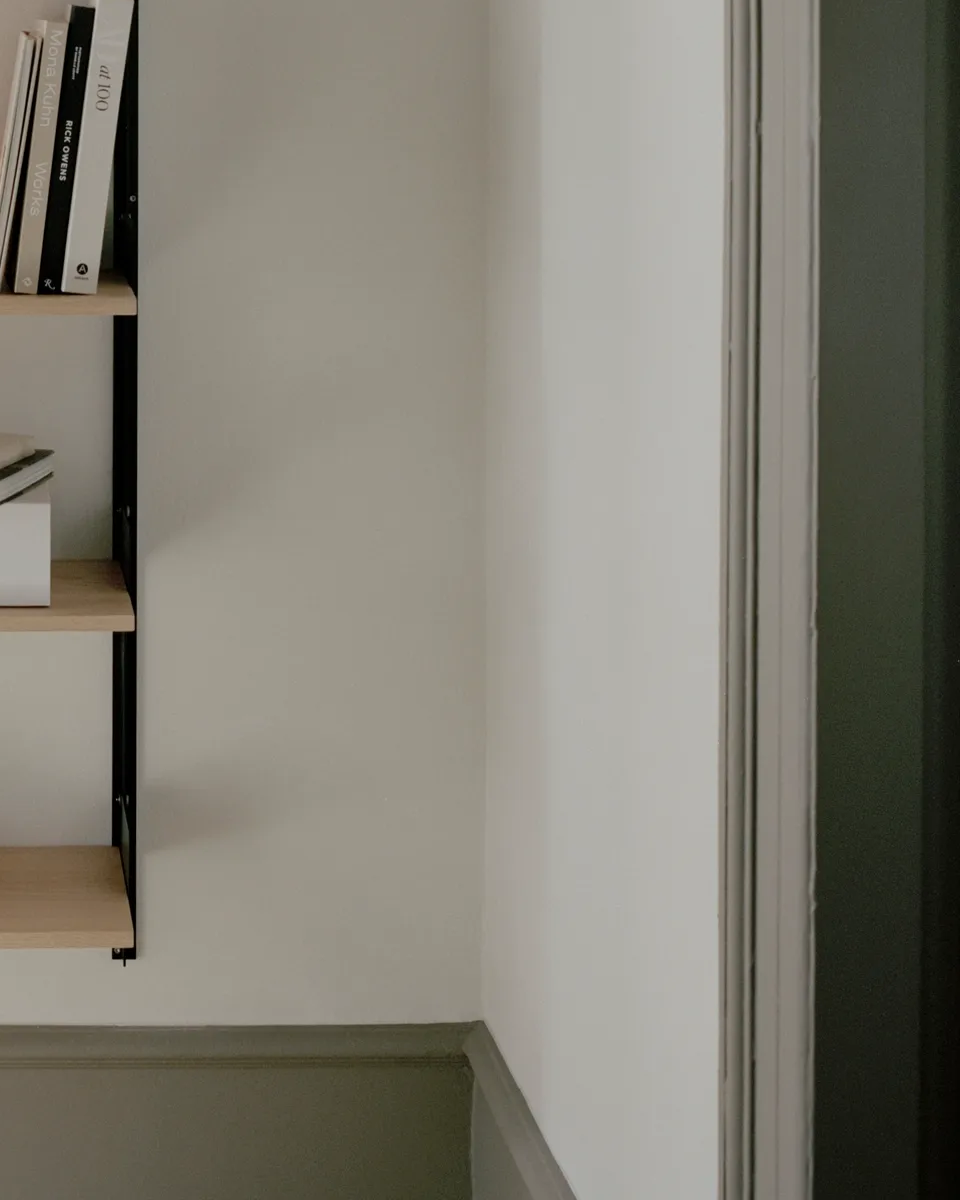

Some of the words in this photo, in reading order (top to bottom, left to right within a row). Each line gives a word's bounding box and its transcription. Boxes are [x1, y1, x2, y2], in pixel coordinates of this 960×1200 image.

[44, 29, 64, 77] Mona
[99, 65, 112, 81] at
[39, 80, 57, 128] Kuhn
[95, 82, 111, 112] 100
[63, 120, 74, 144] RICK
[59, 145, 70, 182] OWENS
[30, 162, 49, 217] Works
